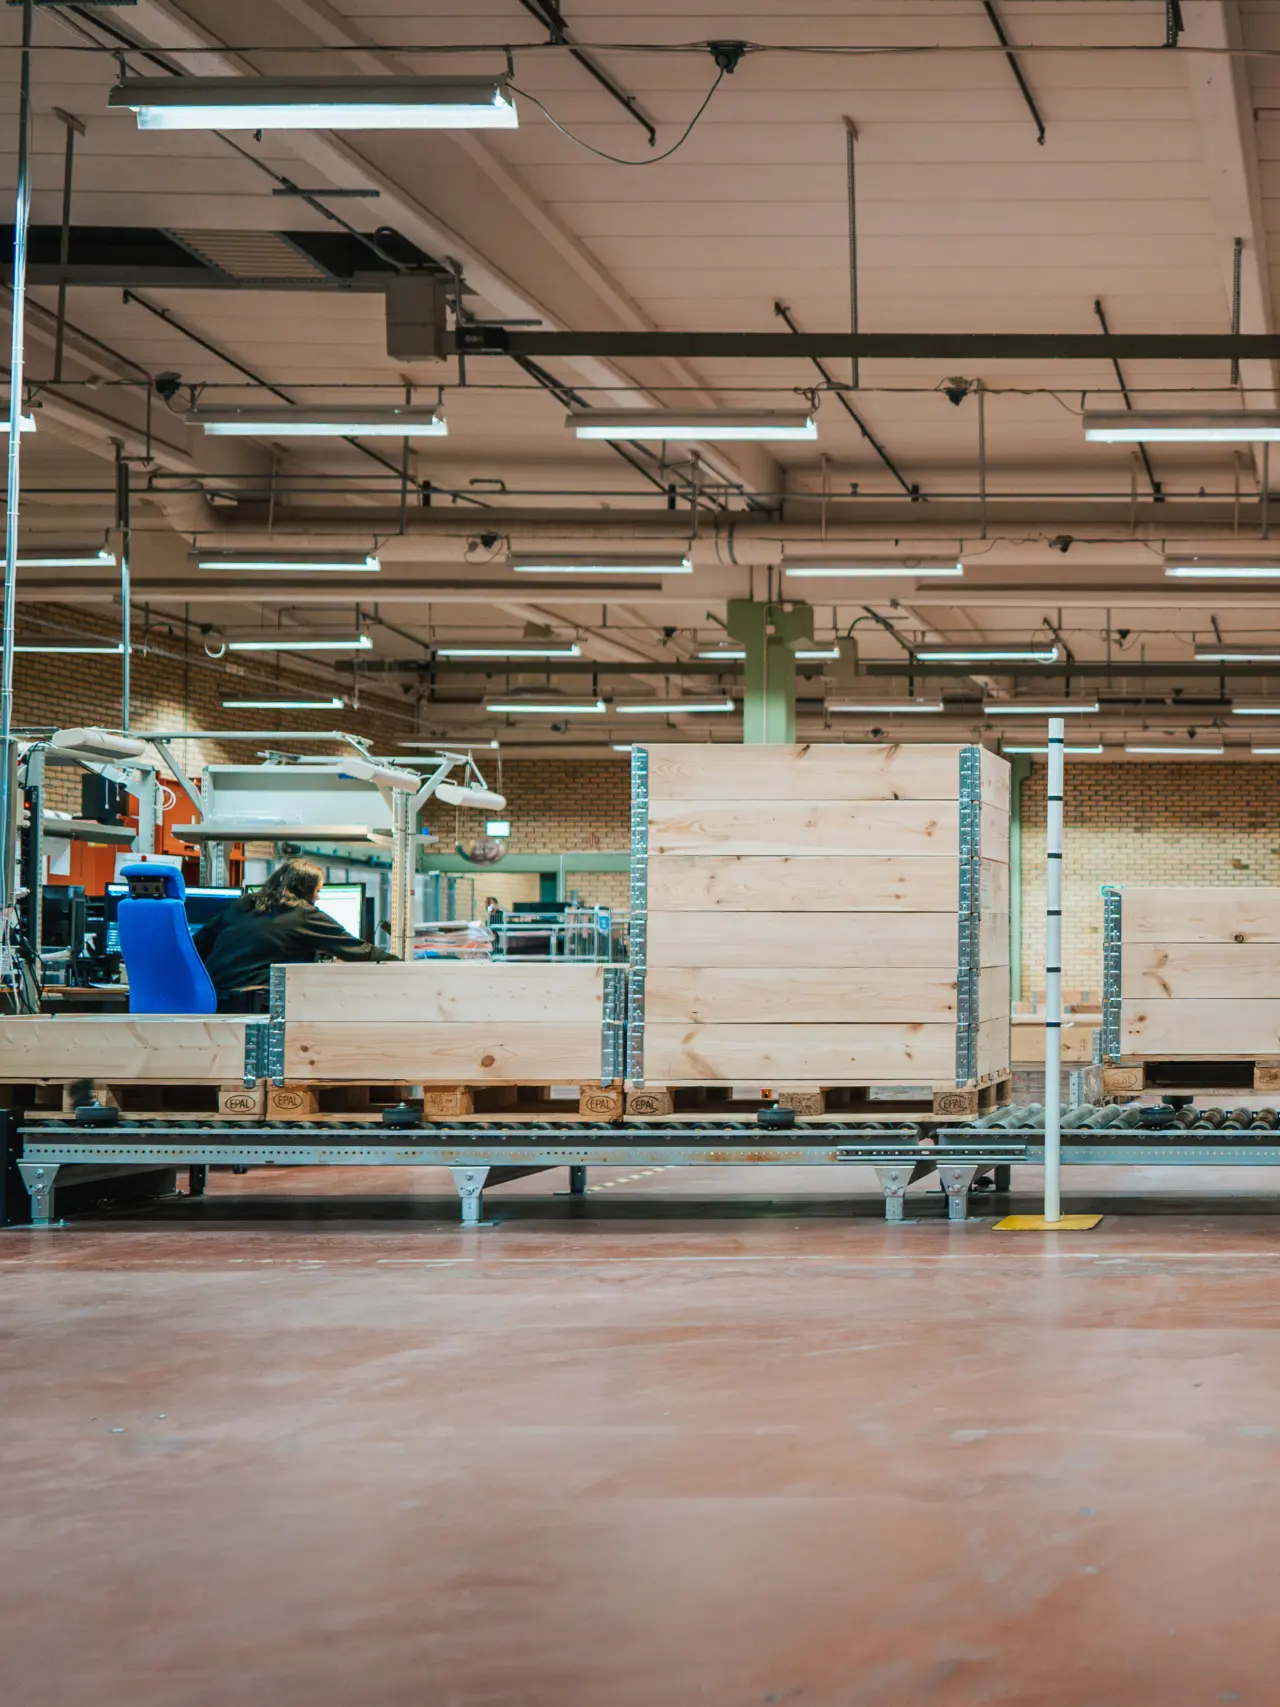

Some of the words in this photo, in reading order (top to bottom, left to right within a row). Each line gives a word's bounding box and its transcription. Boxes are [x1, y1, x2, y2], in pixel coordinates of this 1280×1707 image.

[229, 1098, 250, 1109] EPAL
[278, 1095, 298, 1106] EPAL
[589, 1099, 611, 1110] EPAL
[635, 1099, 655, 1110] EPAL
[943, 1099, 965, 1110] EPAL
